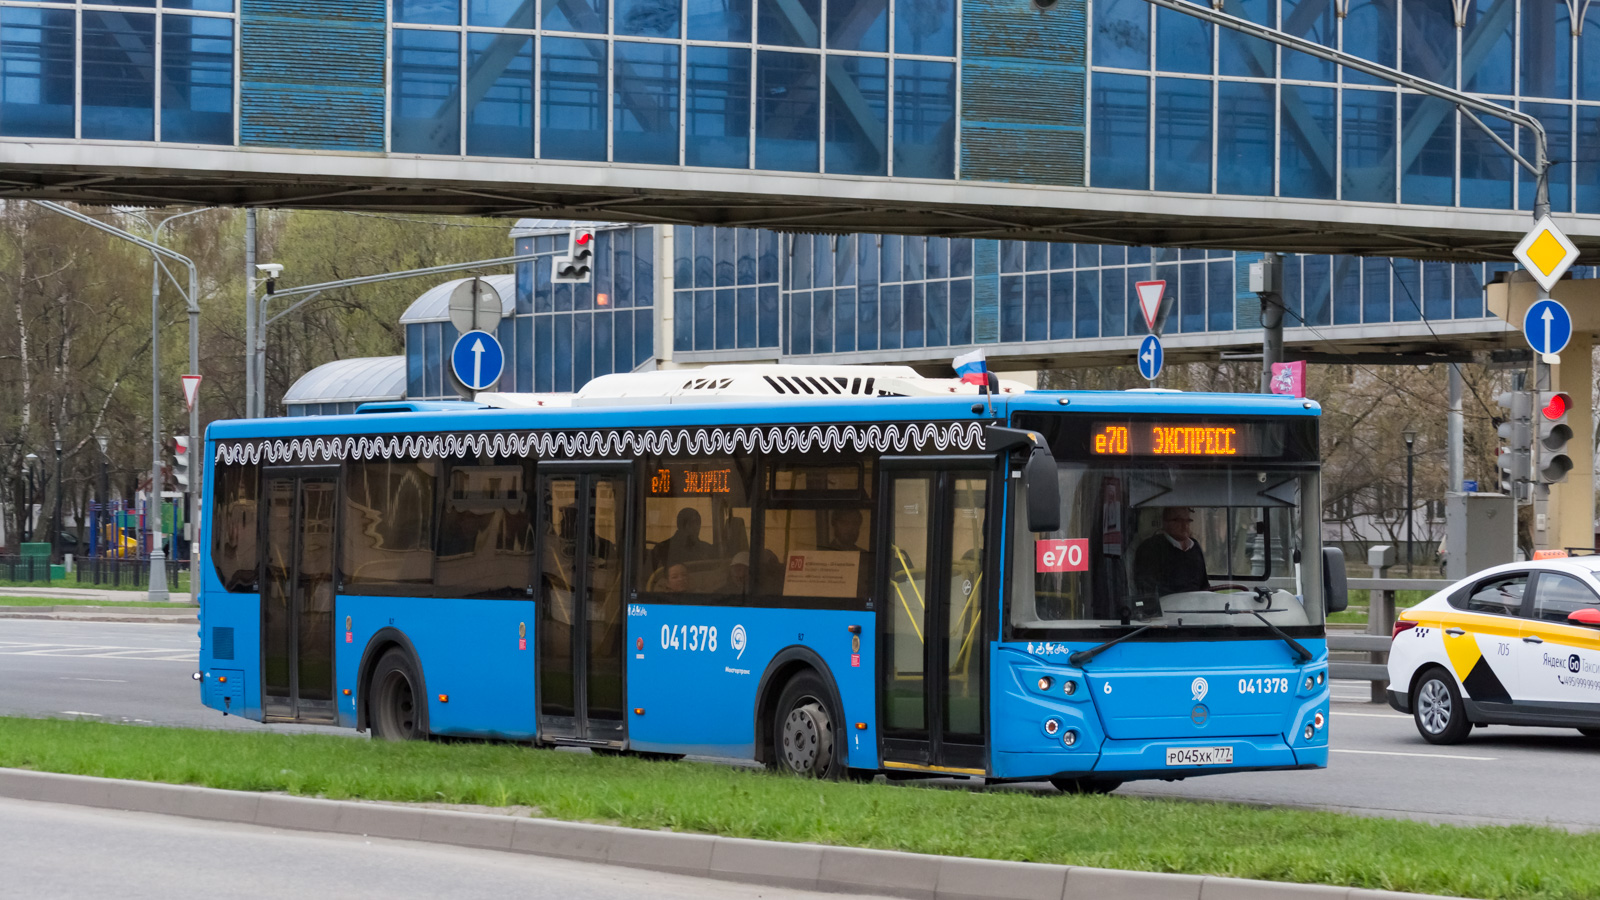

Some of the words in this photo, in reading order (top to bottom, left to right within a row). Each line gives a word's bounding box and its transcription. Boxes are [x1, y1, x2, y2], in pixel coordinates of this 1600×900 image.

[1095, 426, 1128, 454] е70
[1153, 427, 1236, 454] ЭКСПРЕСС
[1042, 545, 1083, 568] е70
[661, 624, 717, 652] 041378
[1498, 643, 1509, 656] 705
[1543, 652, 1567, 669] Яндекс
[1569, 656, 1579, 671] Go
[1104, 682, 1112, 694] 6
[1238, 678, 1288, 694] 041378
[1214, 748, 1231, 759] 777
